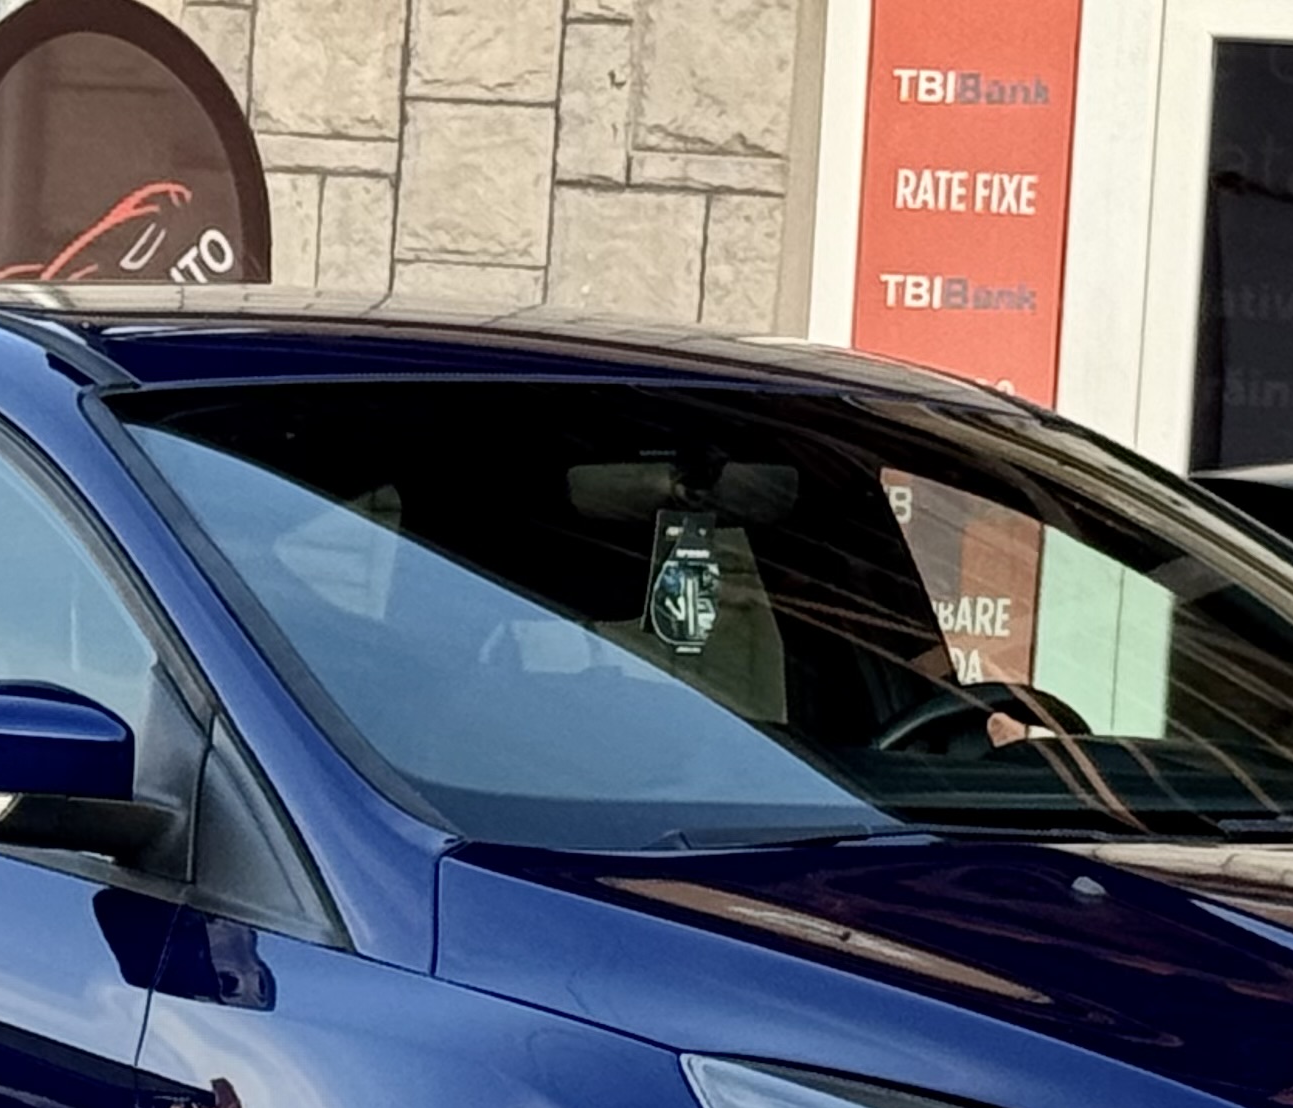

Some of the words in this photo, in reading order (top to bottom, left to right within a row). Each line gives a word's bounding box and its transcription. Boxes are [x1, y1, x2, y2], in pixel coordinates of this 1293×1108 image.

[893, 69, 1049, 105] TBIBank
[895, 169, 968, 212] RATE
[974, 172, 1038, 215] FIXE
[879, 274, 1037, 311] TBIBank
